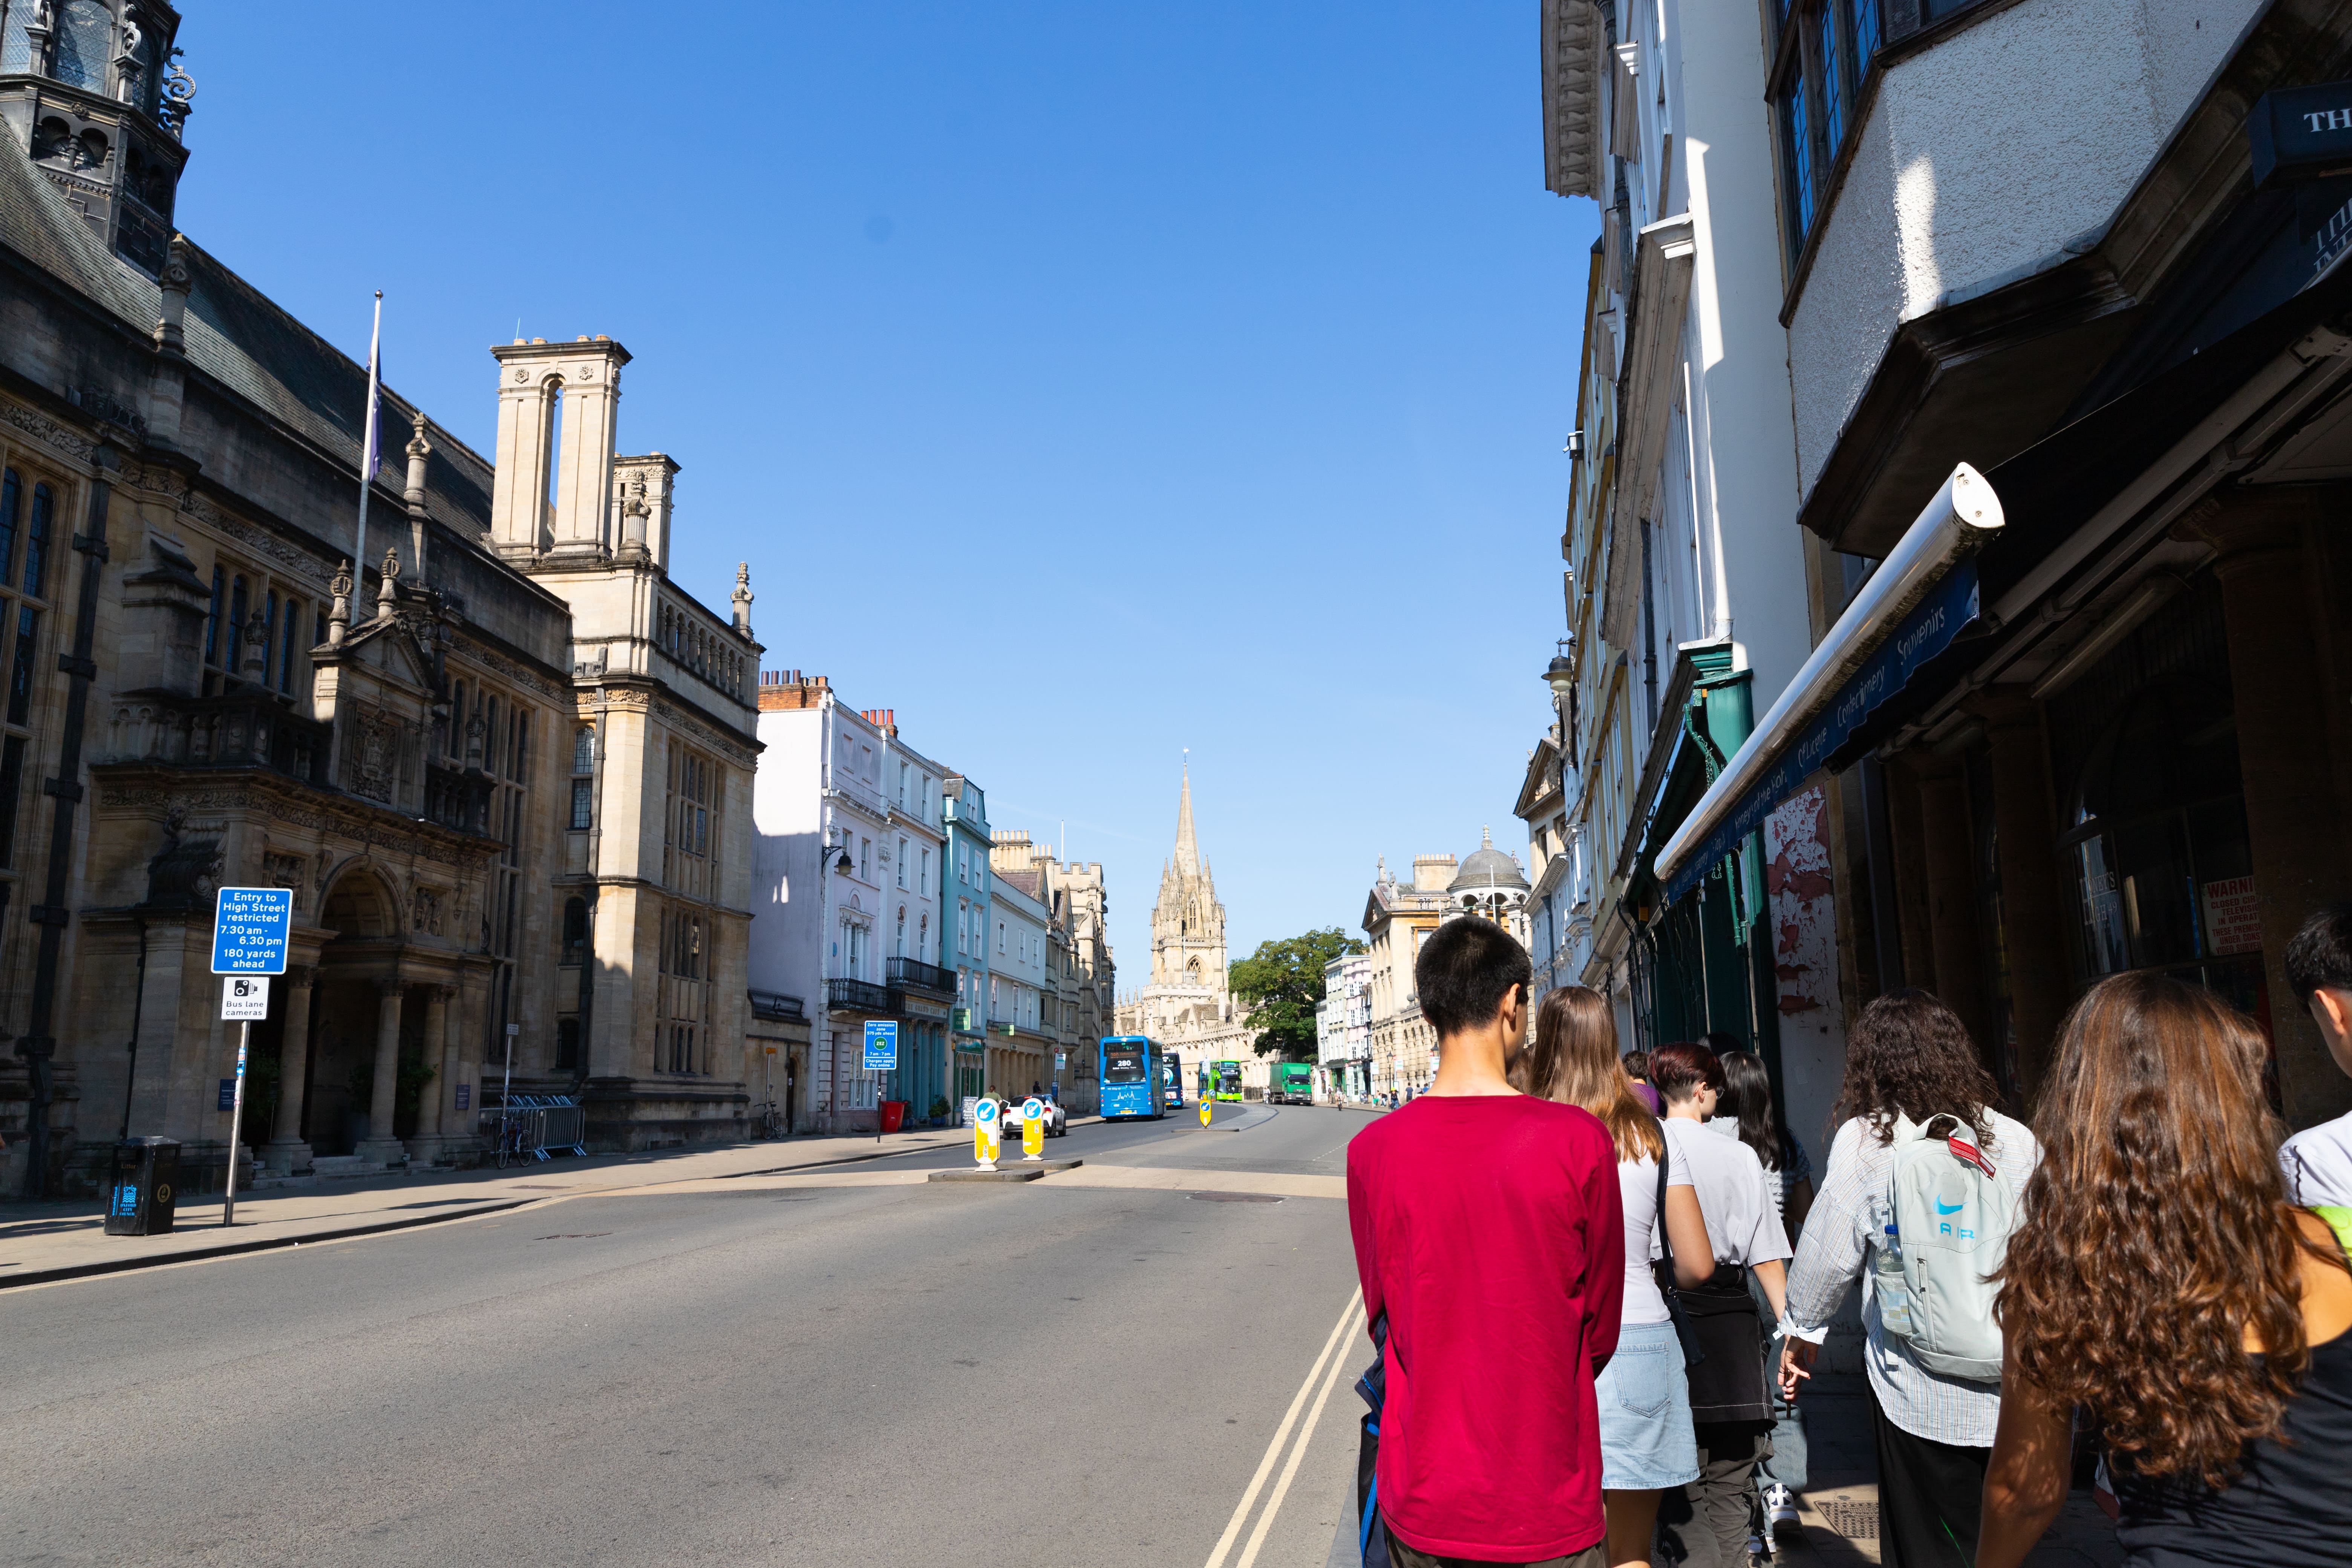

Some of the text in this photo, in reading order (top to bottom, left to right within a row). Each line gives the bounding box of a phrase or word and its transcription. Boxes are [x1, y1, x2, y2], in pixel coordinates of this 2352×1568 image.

[1897, 606, 1945, 665] Souvenirs
[234, 893, 277, 902] Entry to
[2211, 895, 2256, 909] CLOSED CIR
[223, 903, 285, 913] High Street
[227, 913, 279, 922] restricted
[2217, 912, 2259, 925] IN OPERAT
[220, 925, 244, 934] 7.30
[2212, 927, 2231, 937] THESE
[239, 936, 264, 945] 6.30
[2220, 935, 2240, 945] UNDER
[224, 949, 276, 959] 180 yards
[2216, 945, 2234, 955] VIDEO
[233, 960, 265, 968] ahead
[1940, 1222, 1975, 1240] AIR
